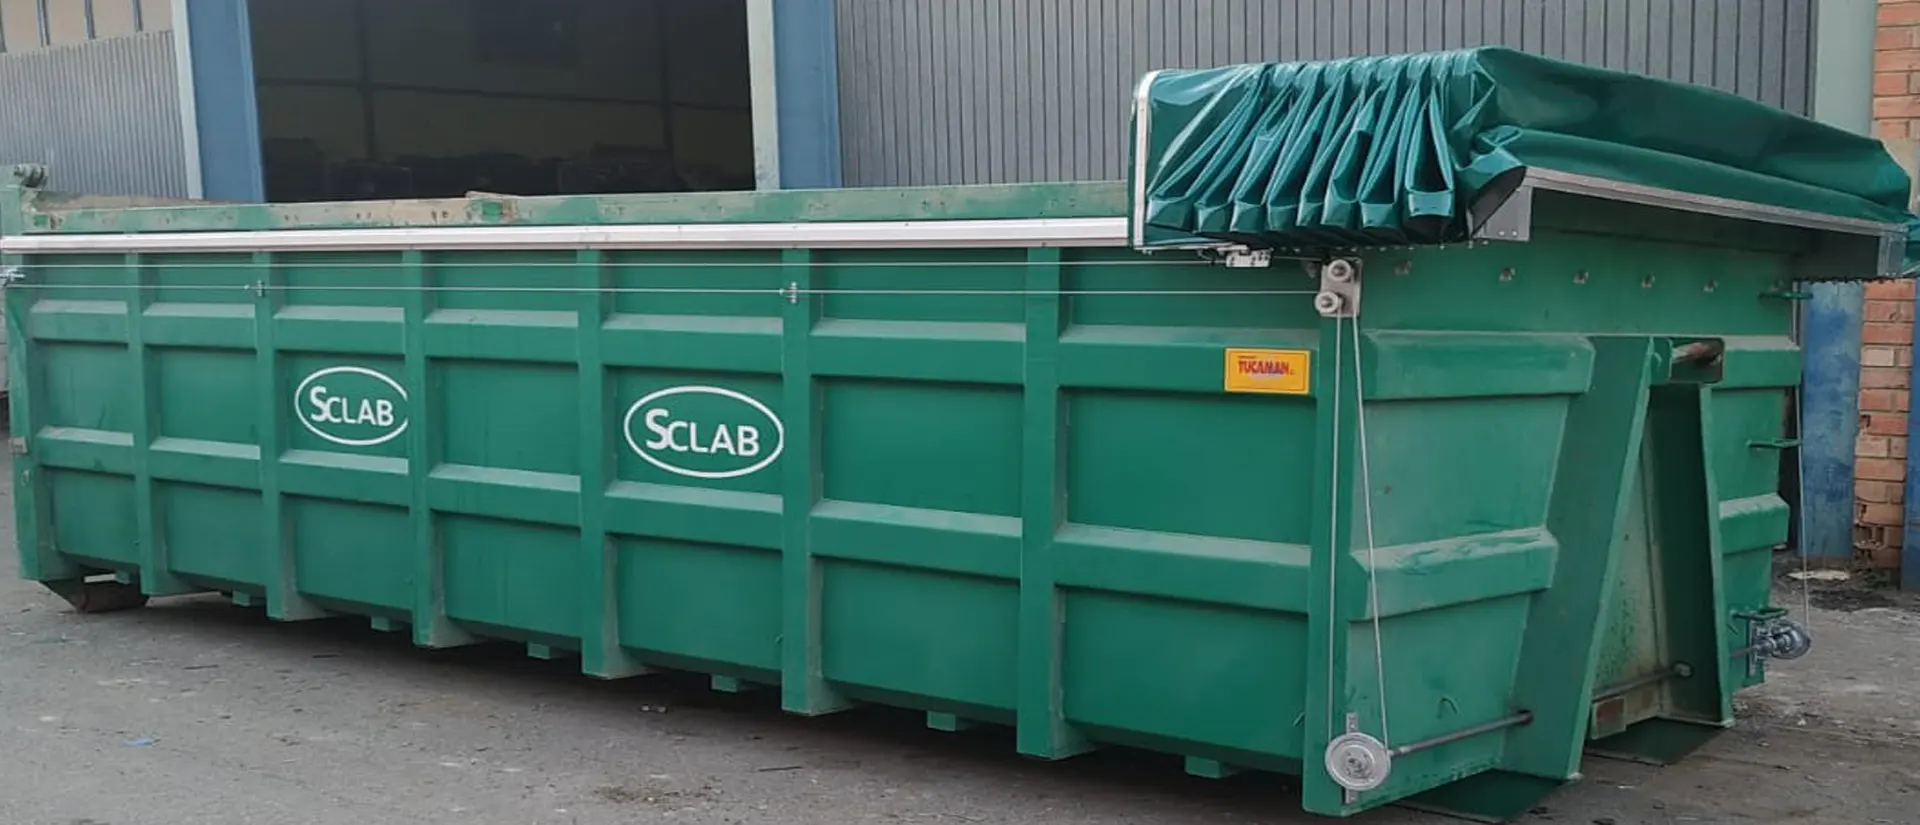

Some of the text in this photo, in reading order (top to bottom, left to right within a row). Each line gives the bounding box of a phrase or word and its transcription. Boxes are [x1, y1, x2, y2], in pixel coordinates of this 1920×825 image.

[1238, 359, 1289, 376] TUCAMAN
[309, 386, 394, 427] SCLAB
[645, 408, 759, 457] SCLAB
